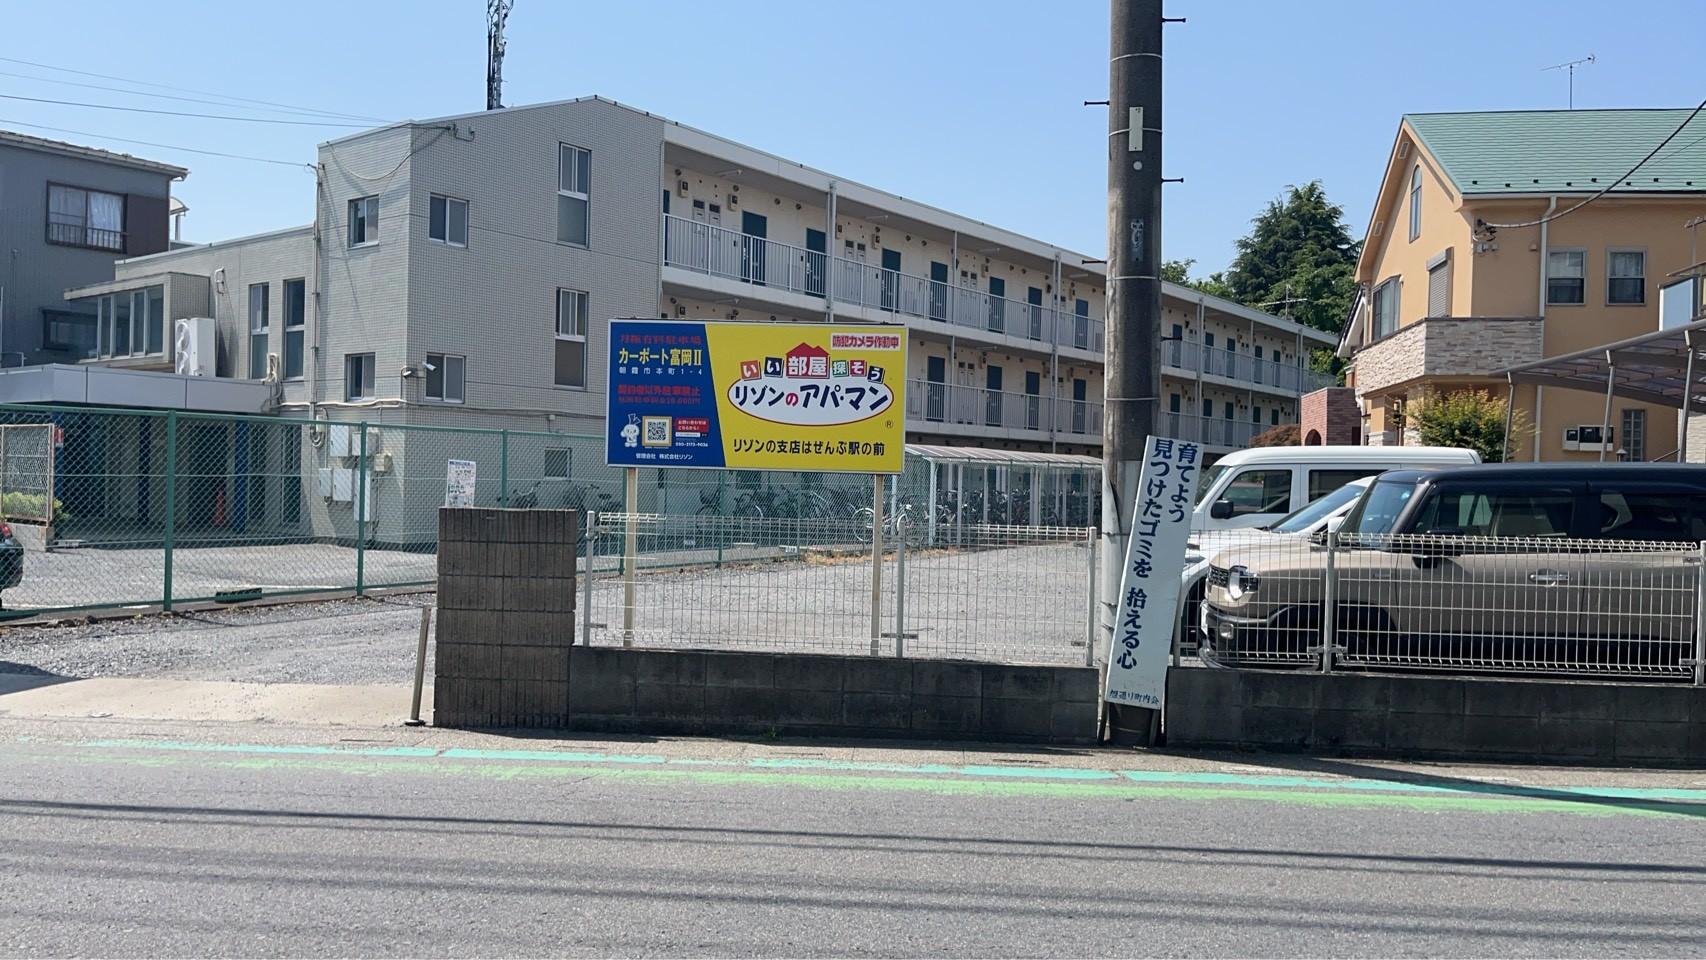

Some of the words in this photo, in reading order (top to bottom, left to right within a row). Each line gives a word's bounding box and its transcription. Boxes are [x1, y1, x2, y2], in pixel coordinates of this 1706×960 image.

[742, 355, 883, 382] いい部屋探そう
[832, 335, 899, 349] 防犯カメラ作動中
[733, 438, 885, 456] リゾンの支店はぜんぶ駅の前
[1133, 438, 1174, 578] 見つけたゴミを
[1168, 443, 1198, 523] 育てよう
[1116, 587, 1148, 670] 拾える心
